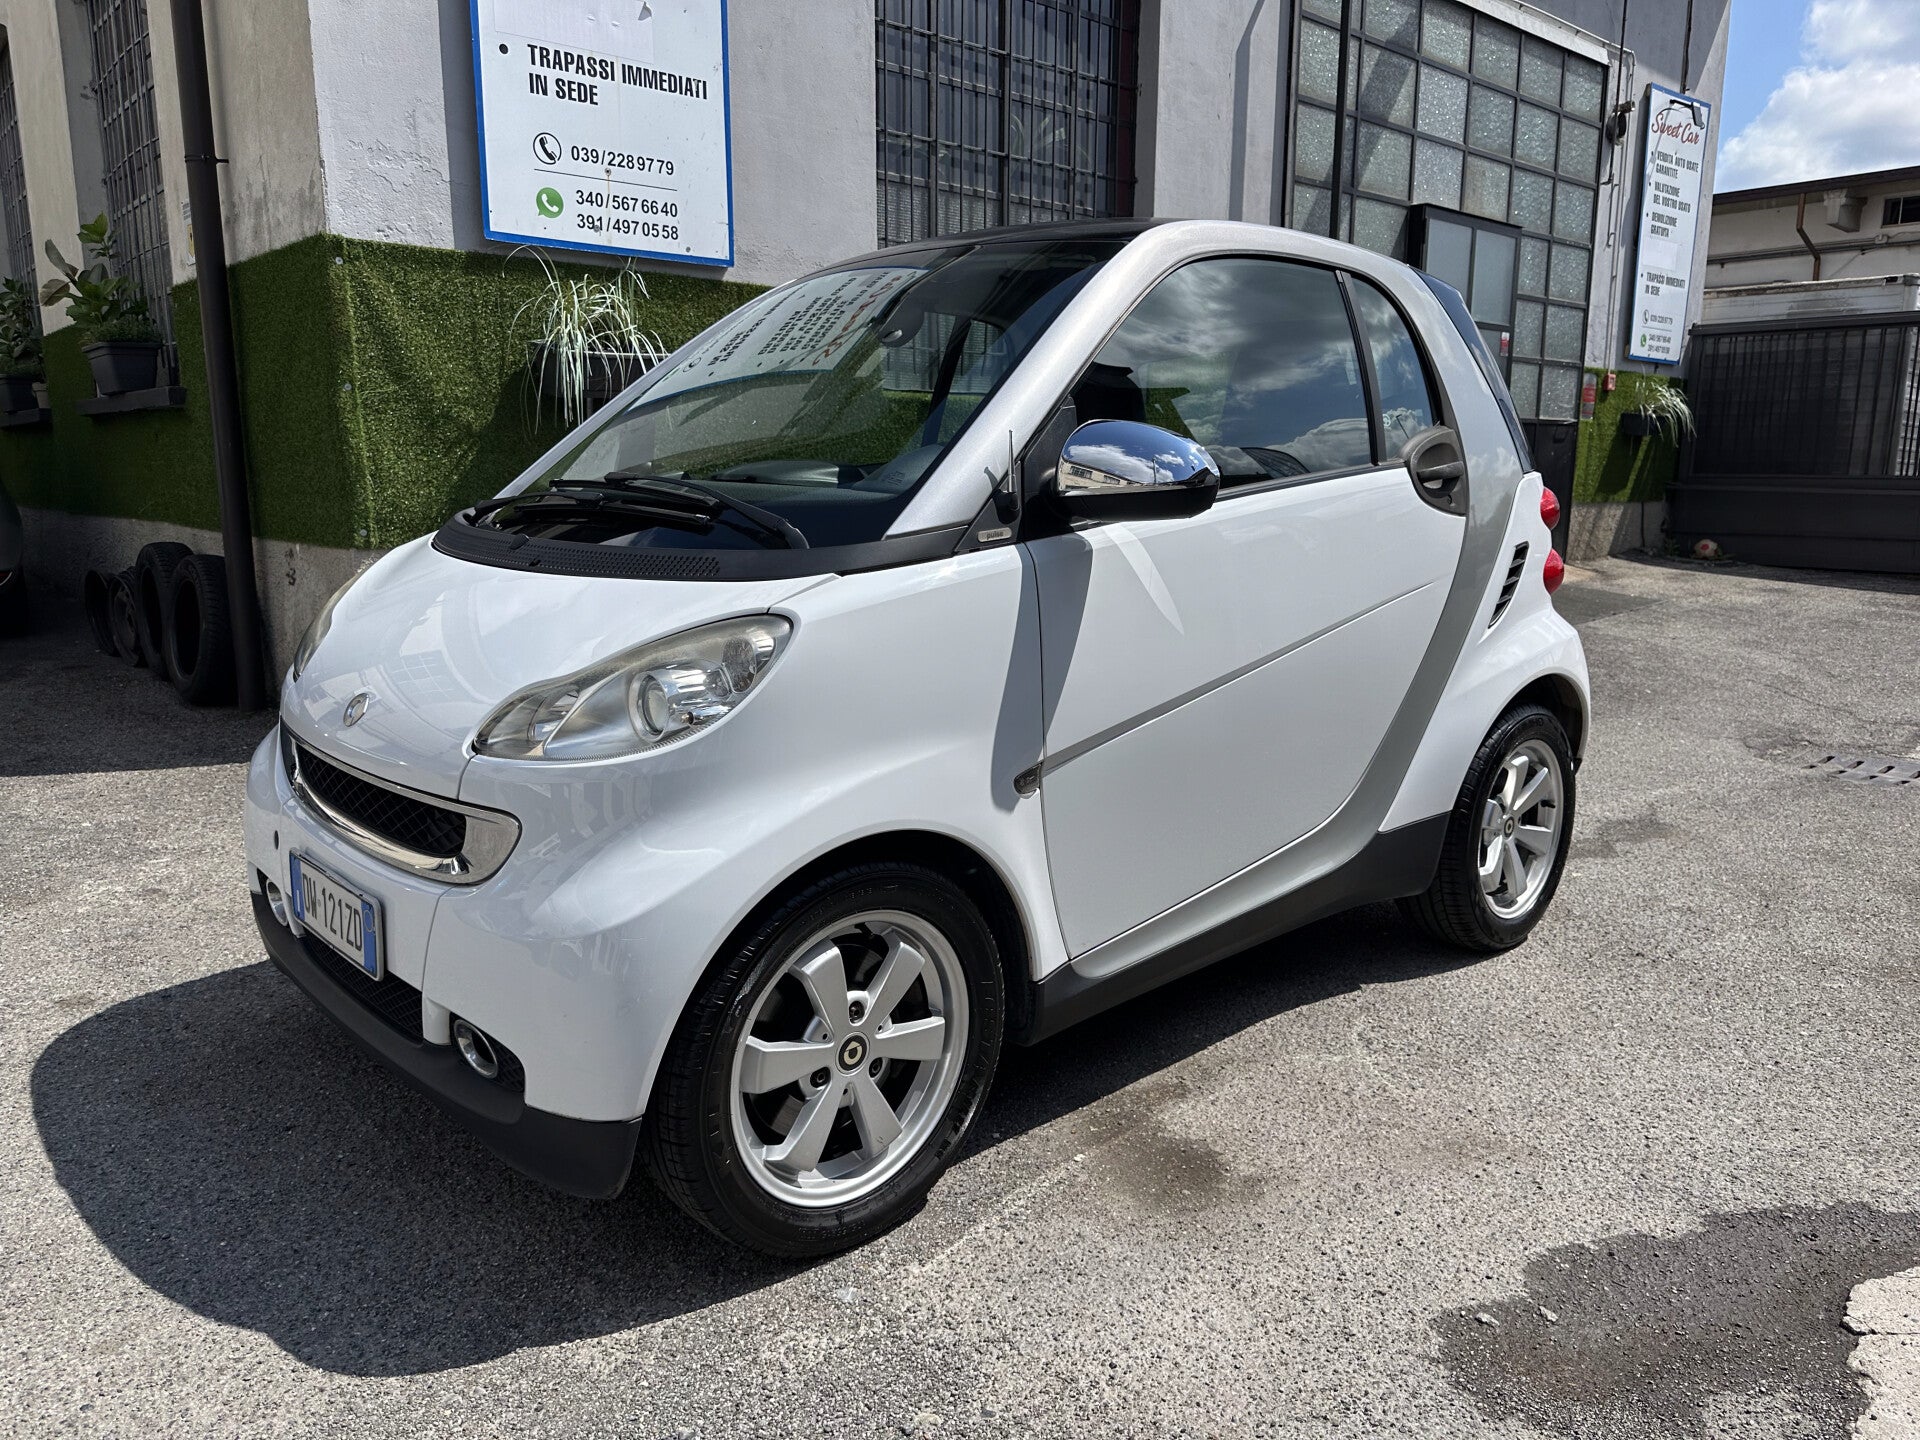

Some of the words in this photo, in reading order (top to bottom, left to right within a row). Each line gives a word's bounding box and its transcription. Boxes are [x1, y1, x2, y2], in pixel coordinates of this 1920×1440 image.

[527, 44, 616, 82] TRAPASSI
[621, 64, 708, 100] IMMEDIATI
[528, 73, 549, 97] IN
[555, 78, 599, 105] SEDE
[1651, 111, 1682, 139] Sweet
[1681, 122, 1700, 145] Car
[571, 146, 675, 176] 039/2289779
[576, 190, 678, 218] 340/5676640
[576, 214, 679, 241] 391/4970558
